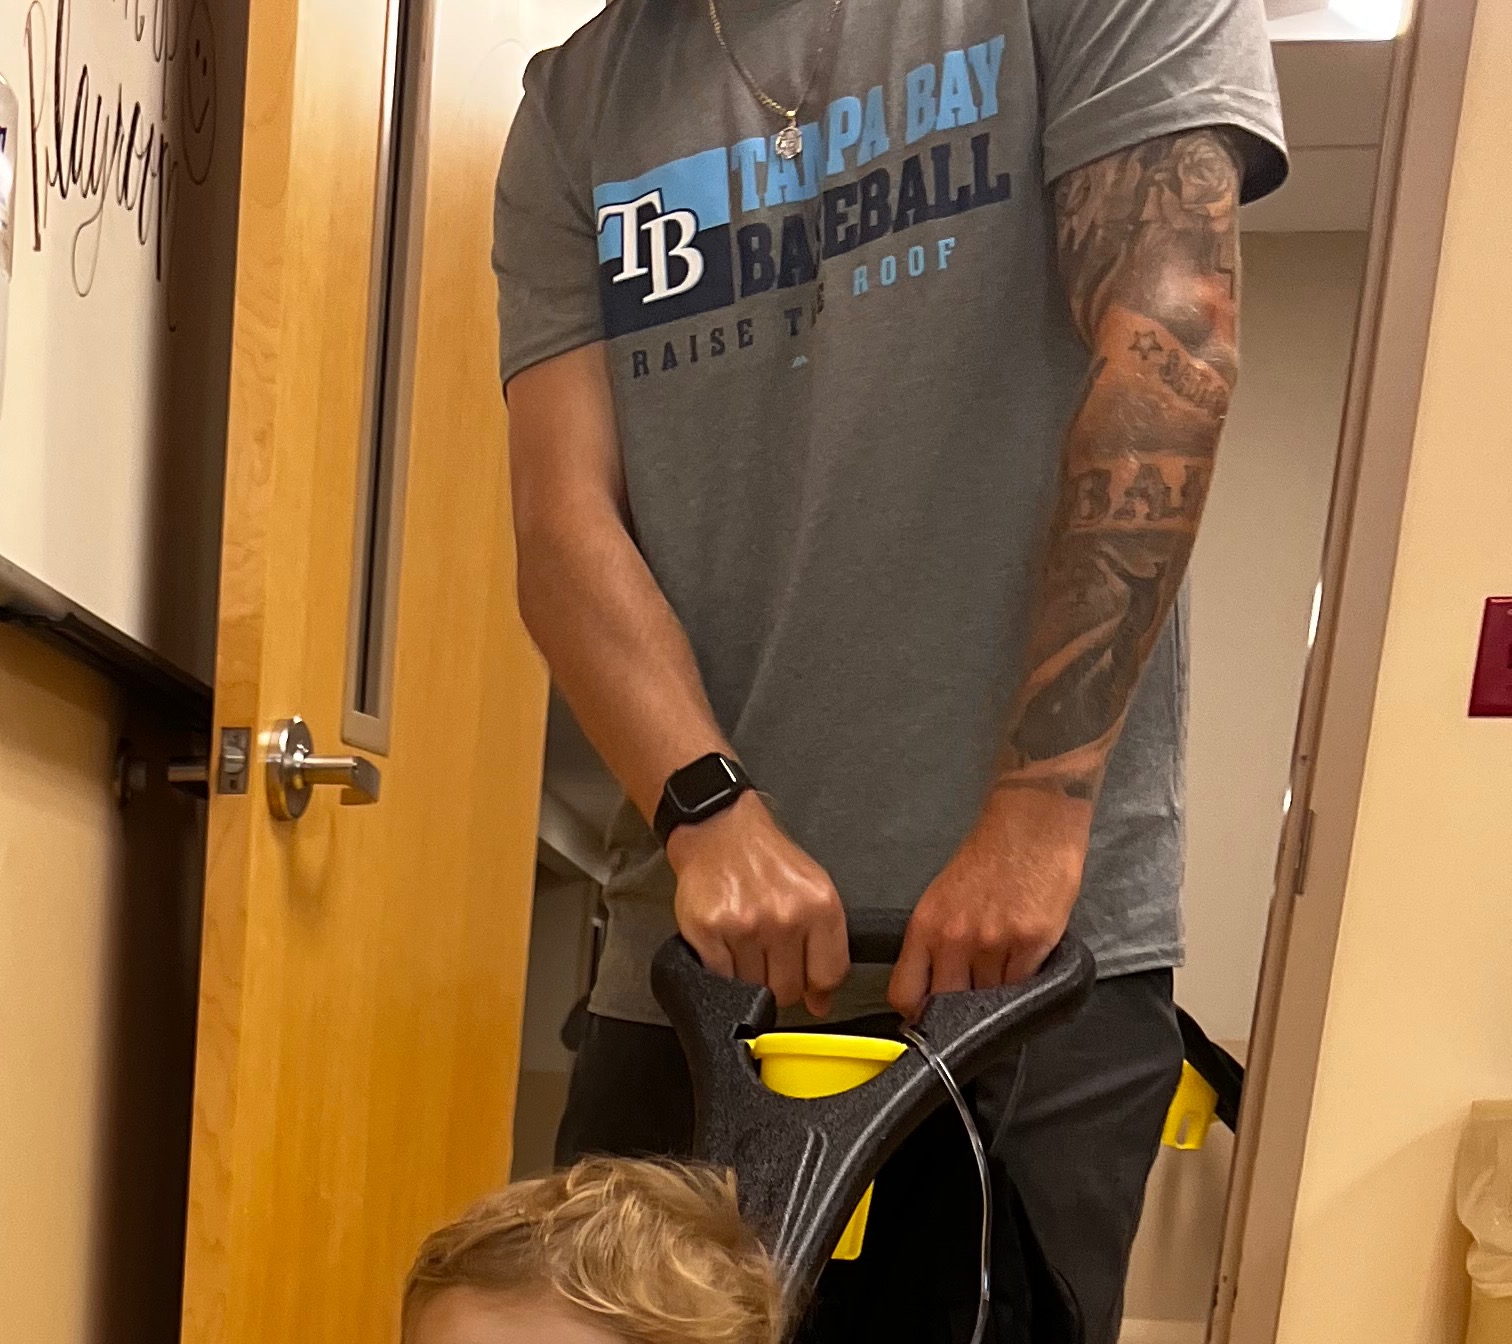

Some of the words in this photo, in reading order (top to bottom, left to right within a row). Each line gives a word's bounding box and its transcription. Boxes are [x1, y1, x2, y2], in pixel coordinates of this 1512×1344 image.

[905, 34, 1005, 145] BAY
[597, 188, 705, 304] TB
[737, 132, 1011, 298] BAEBALL
[631, 317, 755, 379] RAISE
[852, 237, 956, 297] ROOF
